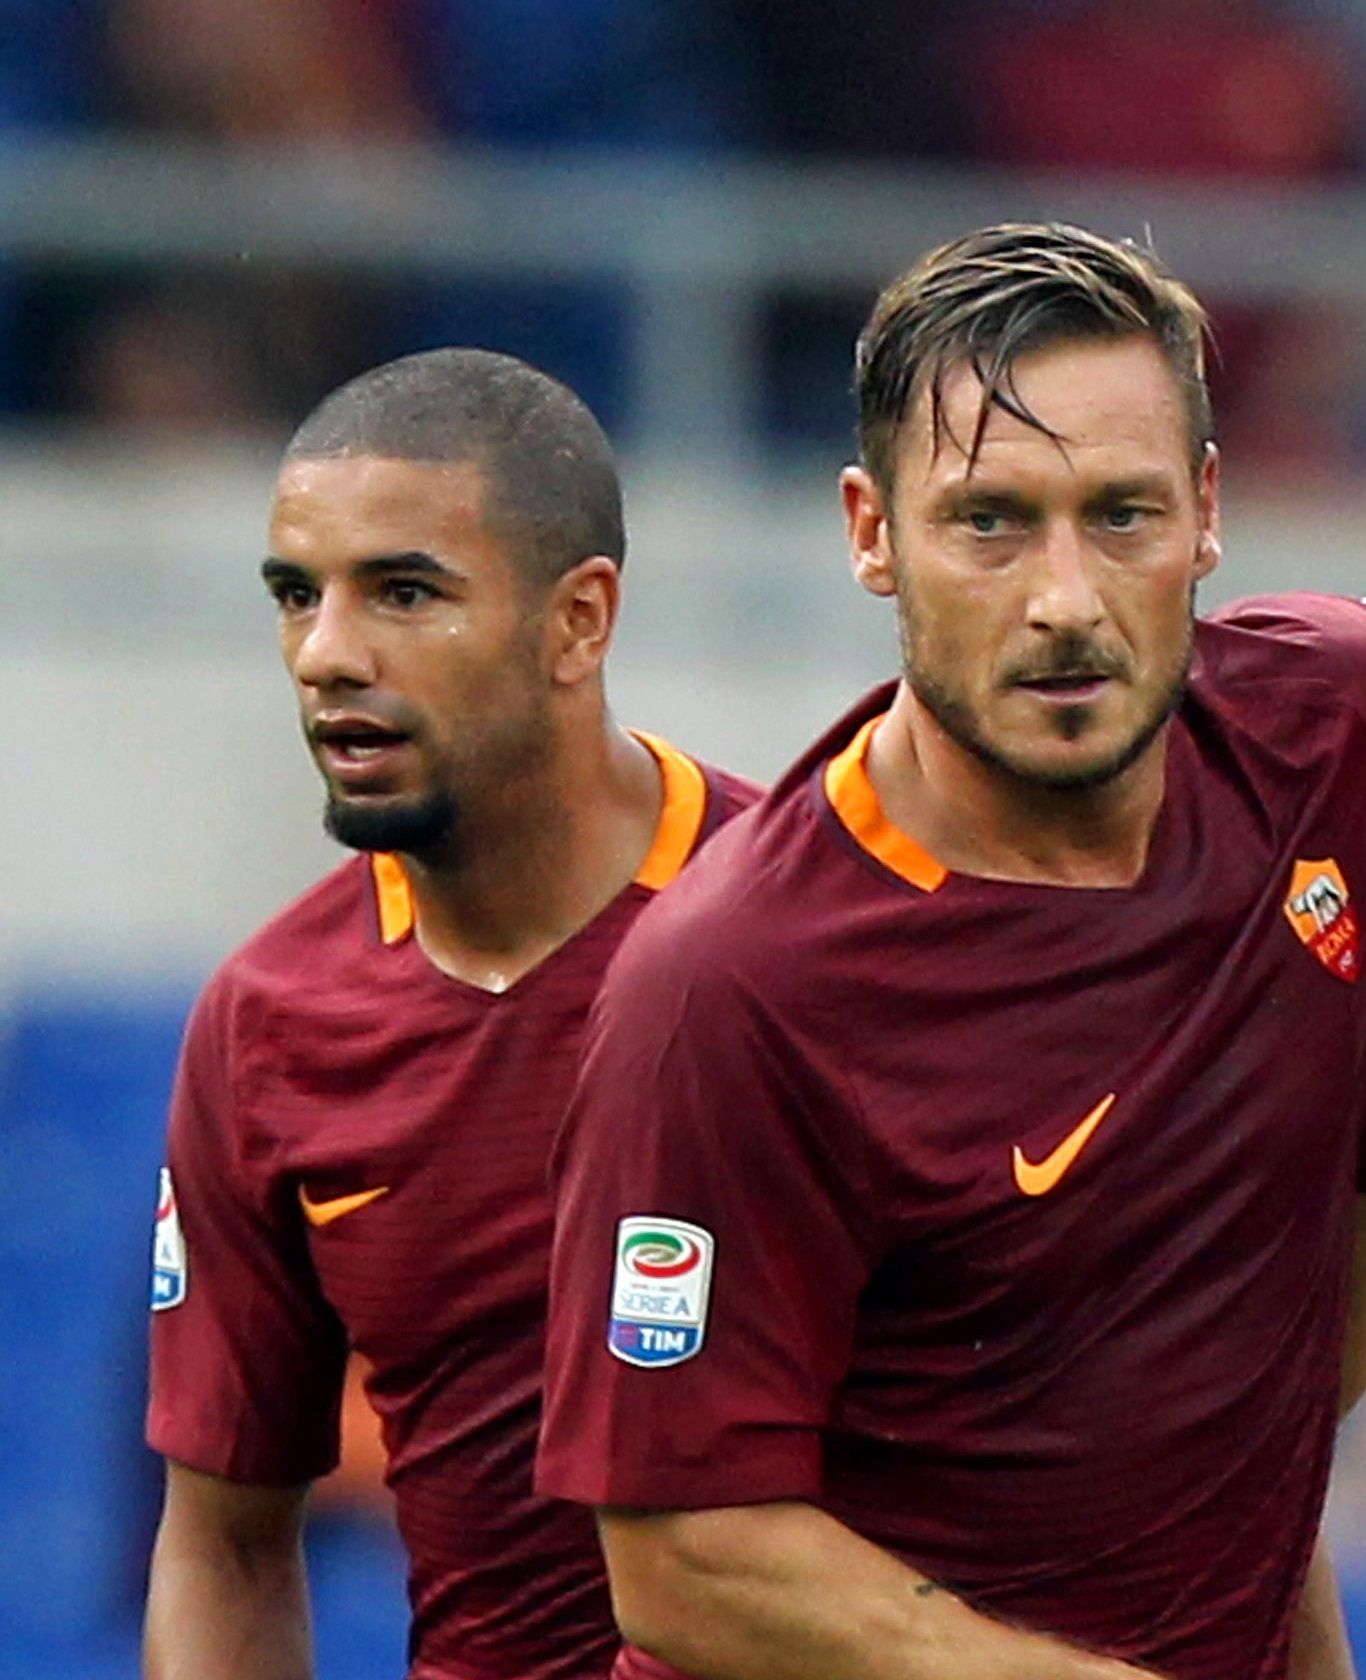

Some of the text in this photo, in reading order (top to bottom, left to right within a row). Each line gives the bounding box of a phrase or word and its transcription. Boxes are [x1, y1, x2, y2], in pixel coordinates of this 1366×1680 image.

[1316, 917, 1356, 965] ROMA
[620, 1289, 690, 1317] SERIE A
[639, 1327, 687, 1352] TIM
